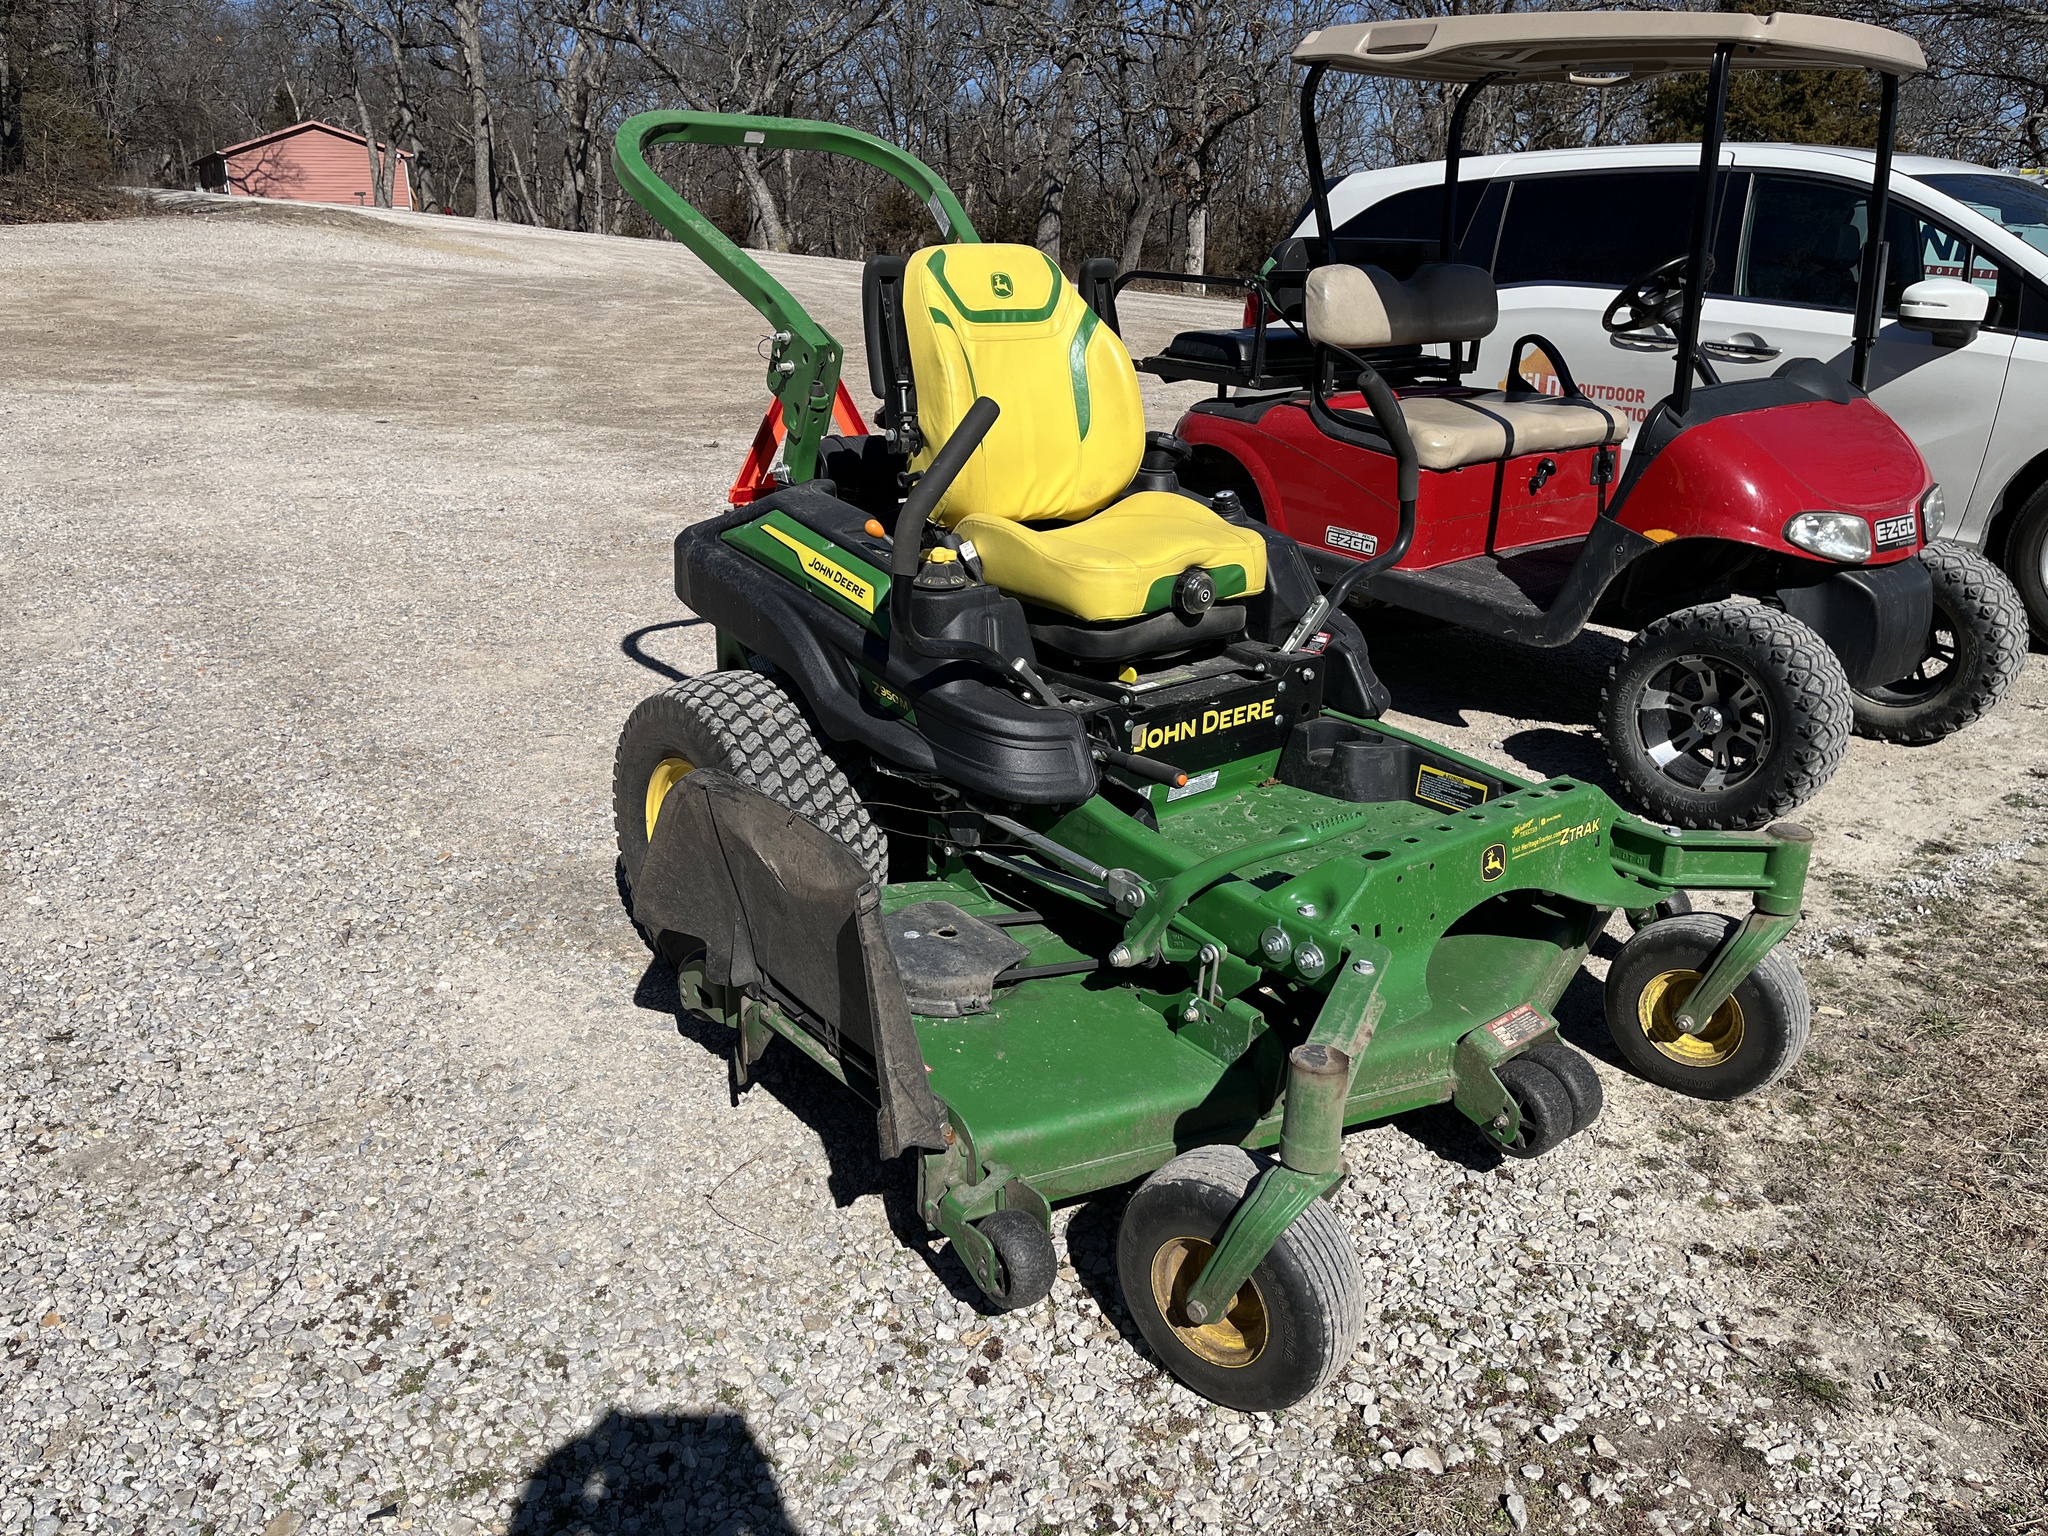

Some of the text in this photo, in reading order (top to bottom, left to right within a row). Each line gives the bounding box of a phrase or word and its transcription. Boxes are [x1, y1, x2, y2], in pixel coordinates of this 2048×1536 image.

[808, 557, 866, 599] JOHN DEERE
[1133, 698, 1275, 753] JOHN DEERE
[1560, 817, 1600, 846] ZTRAK
[1260, 1260, 1297, 1363] ARLISLE
